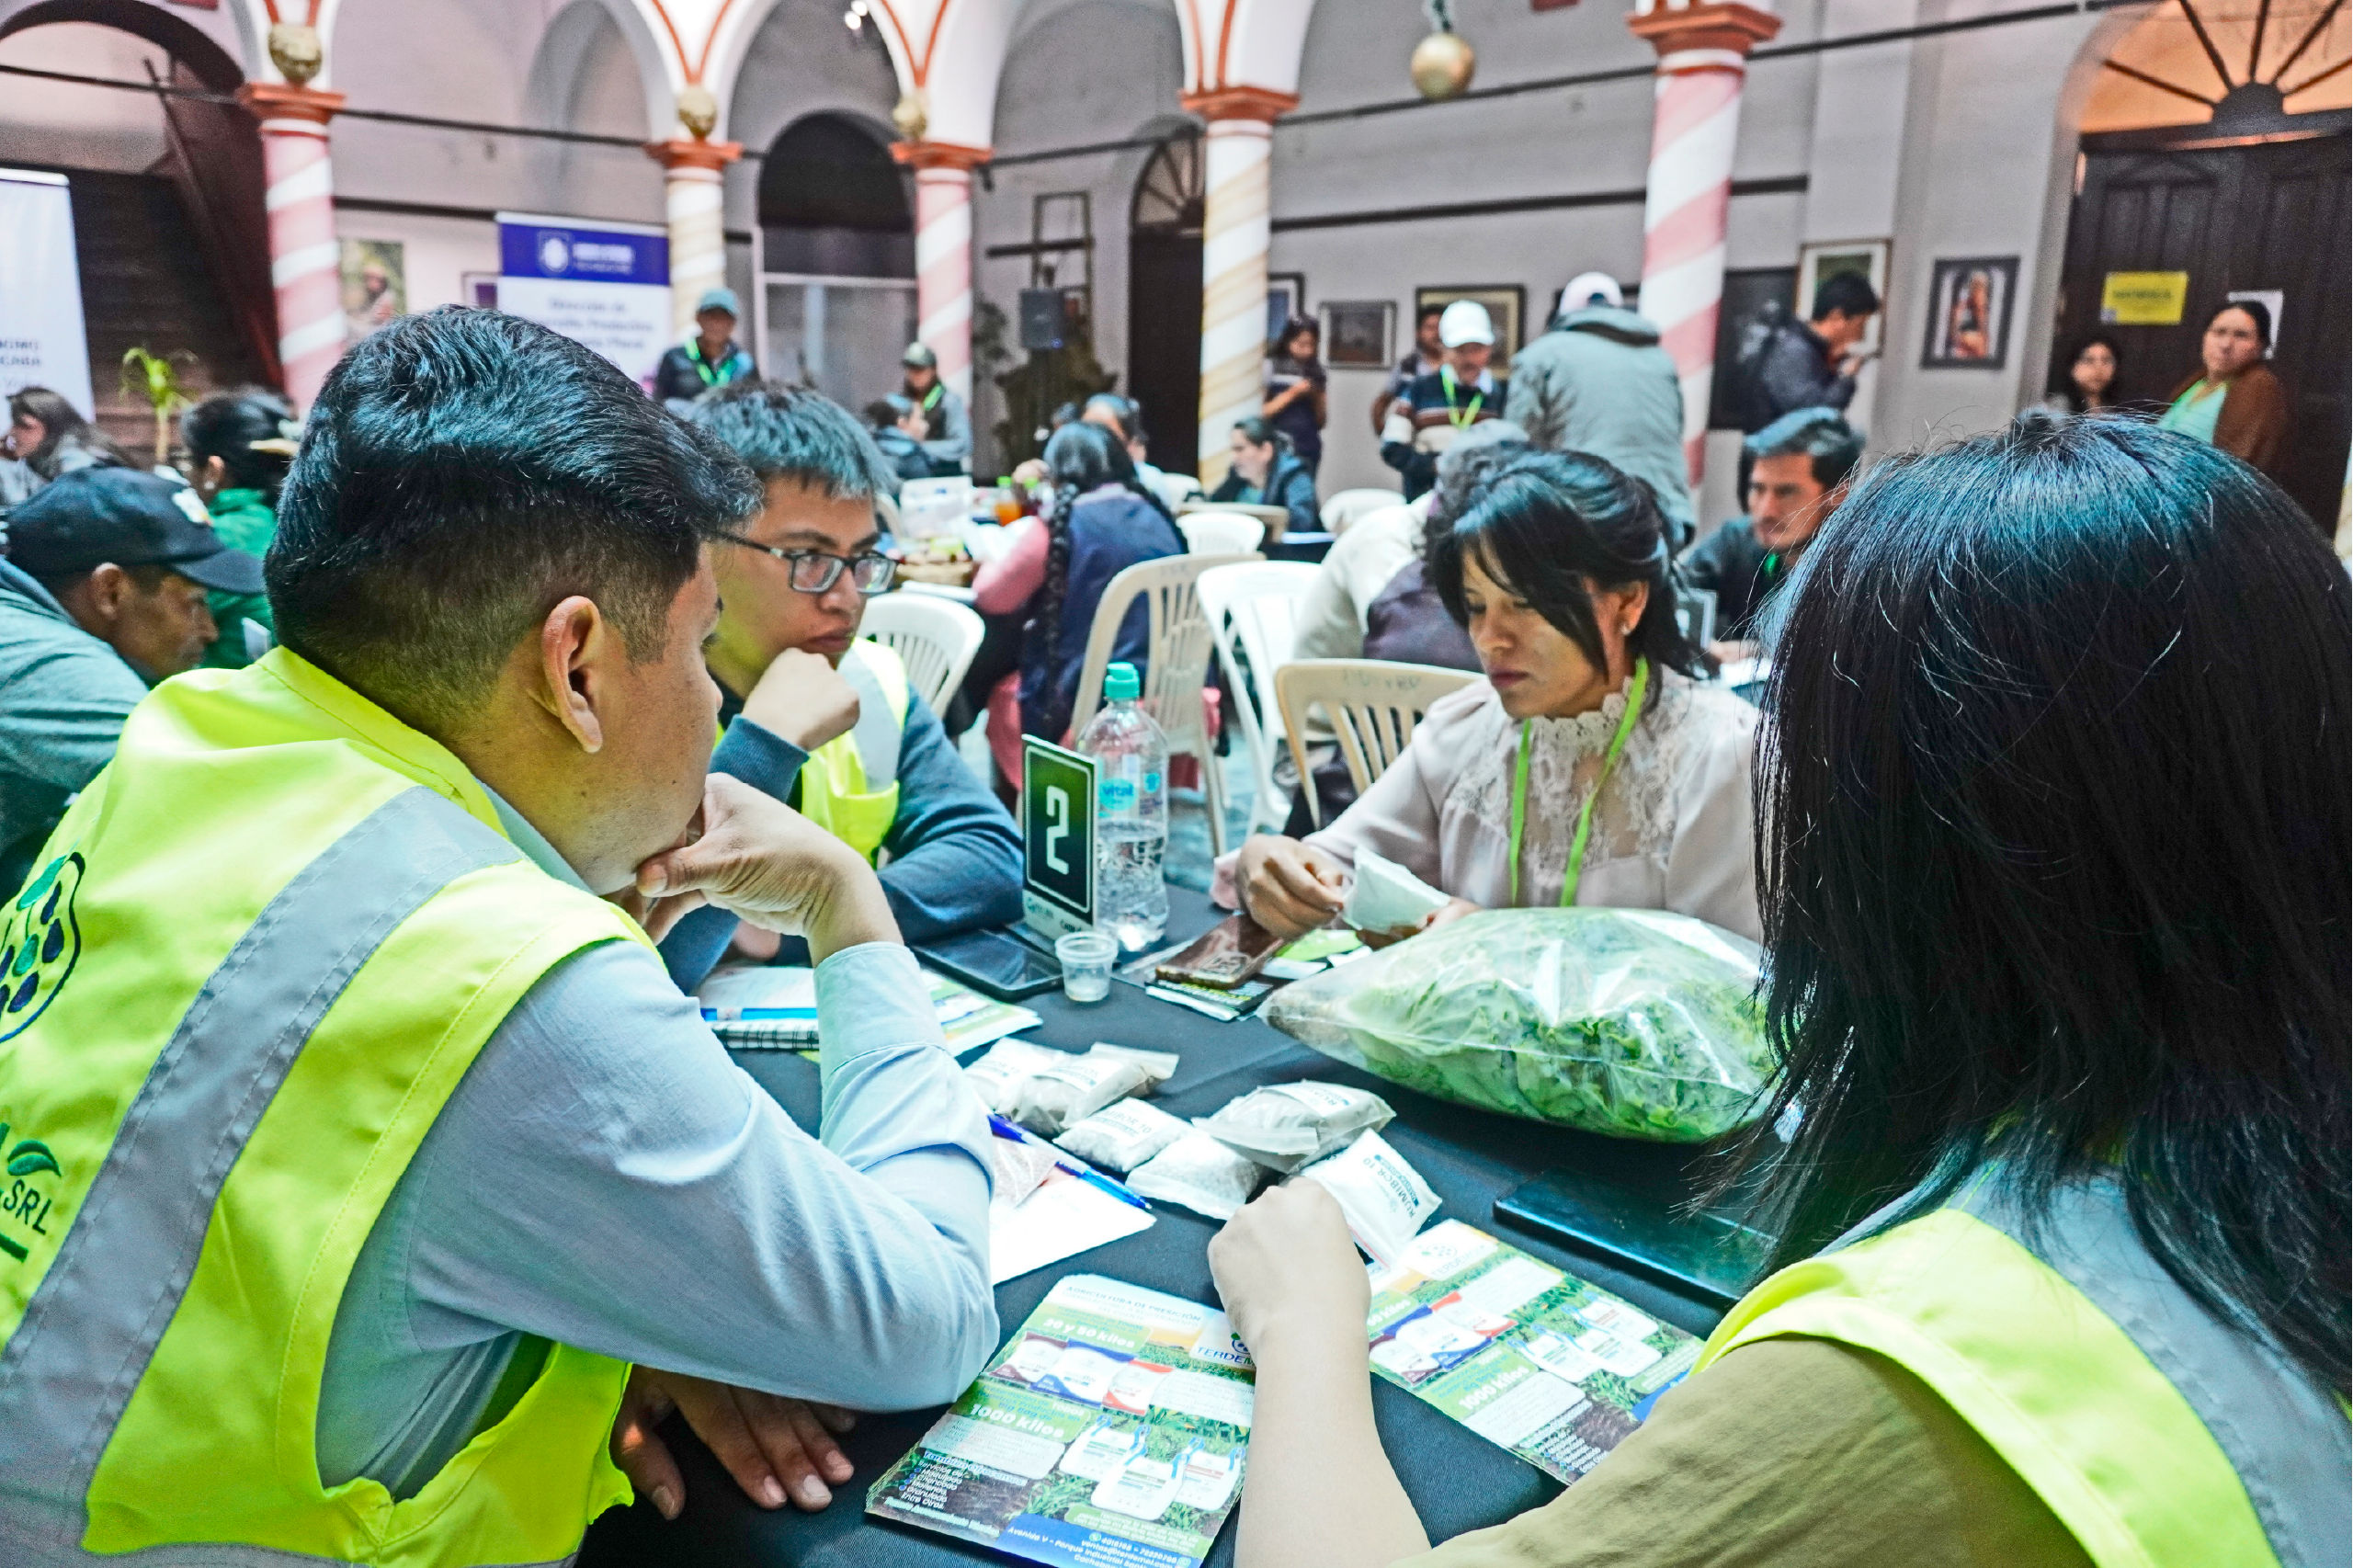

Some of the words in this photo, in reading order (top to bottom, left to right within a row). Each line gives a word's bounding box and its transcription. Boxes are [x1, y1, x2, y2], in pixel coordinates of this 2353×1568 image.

[1046, 785, 1070, 875] 2
[1363, 1157, 1376, 1169] 10
[3, 1179, 52, 1236] SRL
[1377, 1168, 1415, 1218] RUMIBOR
[1066, 1285, 1132, 1306] AGRICULTURA
[1148, 1304, 1200, 1322] PRESICIÓN
[1384, 1298, 1411, 1320] kilos
[1044, 1317, 1063, 1329] 20
[1063, 1323, 1074, 1334] y
[1076, 1325, 1097, 1338] 50
[1097, 1331, 1136, 1348] kilos
[982, 1385, 1038, 1403] Presentación
[1051, 1403, 1085, 1416] TODOS
[1459, 1384, 1497, 1410] 1000
[1491, 1366, 1529, 1390] kilos
[970, 1403, 1016, 1425] 1000
[1016, 1415, 1066, 1438] kilos
[997, 1402, 1015, 1412] Big
[1016, 1406, 1038, 1418] Bag
[1039, 1413, 1052, 1421] de
[1018, 1401, 1066, 1417] Productos
[1006, 1525, 1041, 1541] Avenida
[1053, 1540, 1085, 1554] Parque
[1083, 1549, 1123, 1565] Industrial
